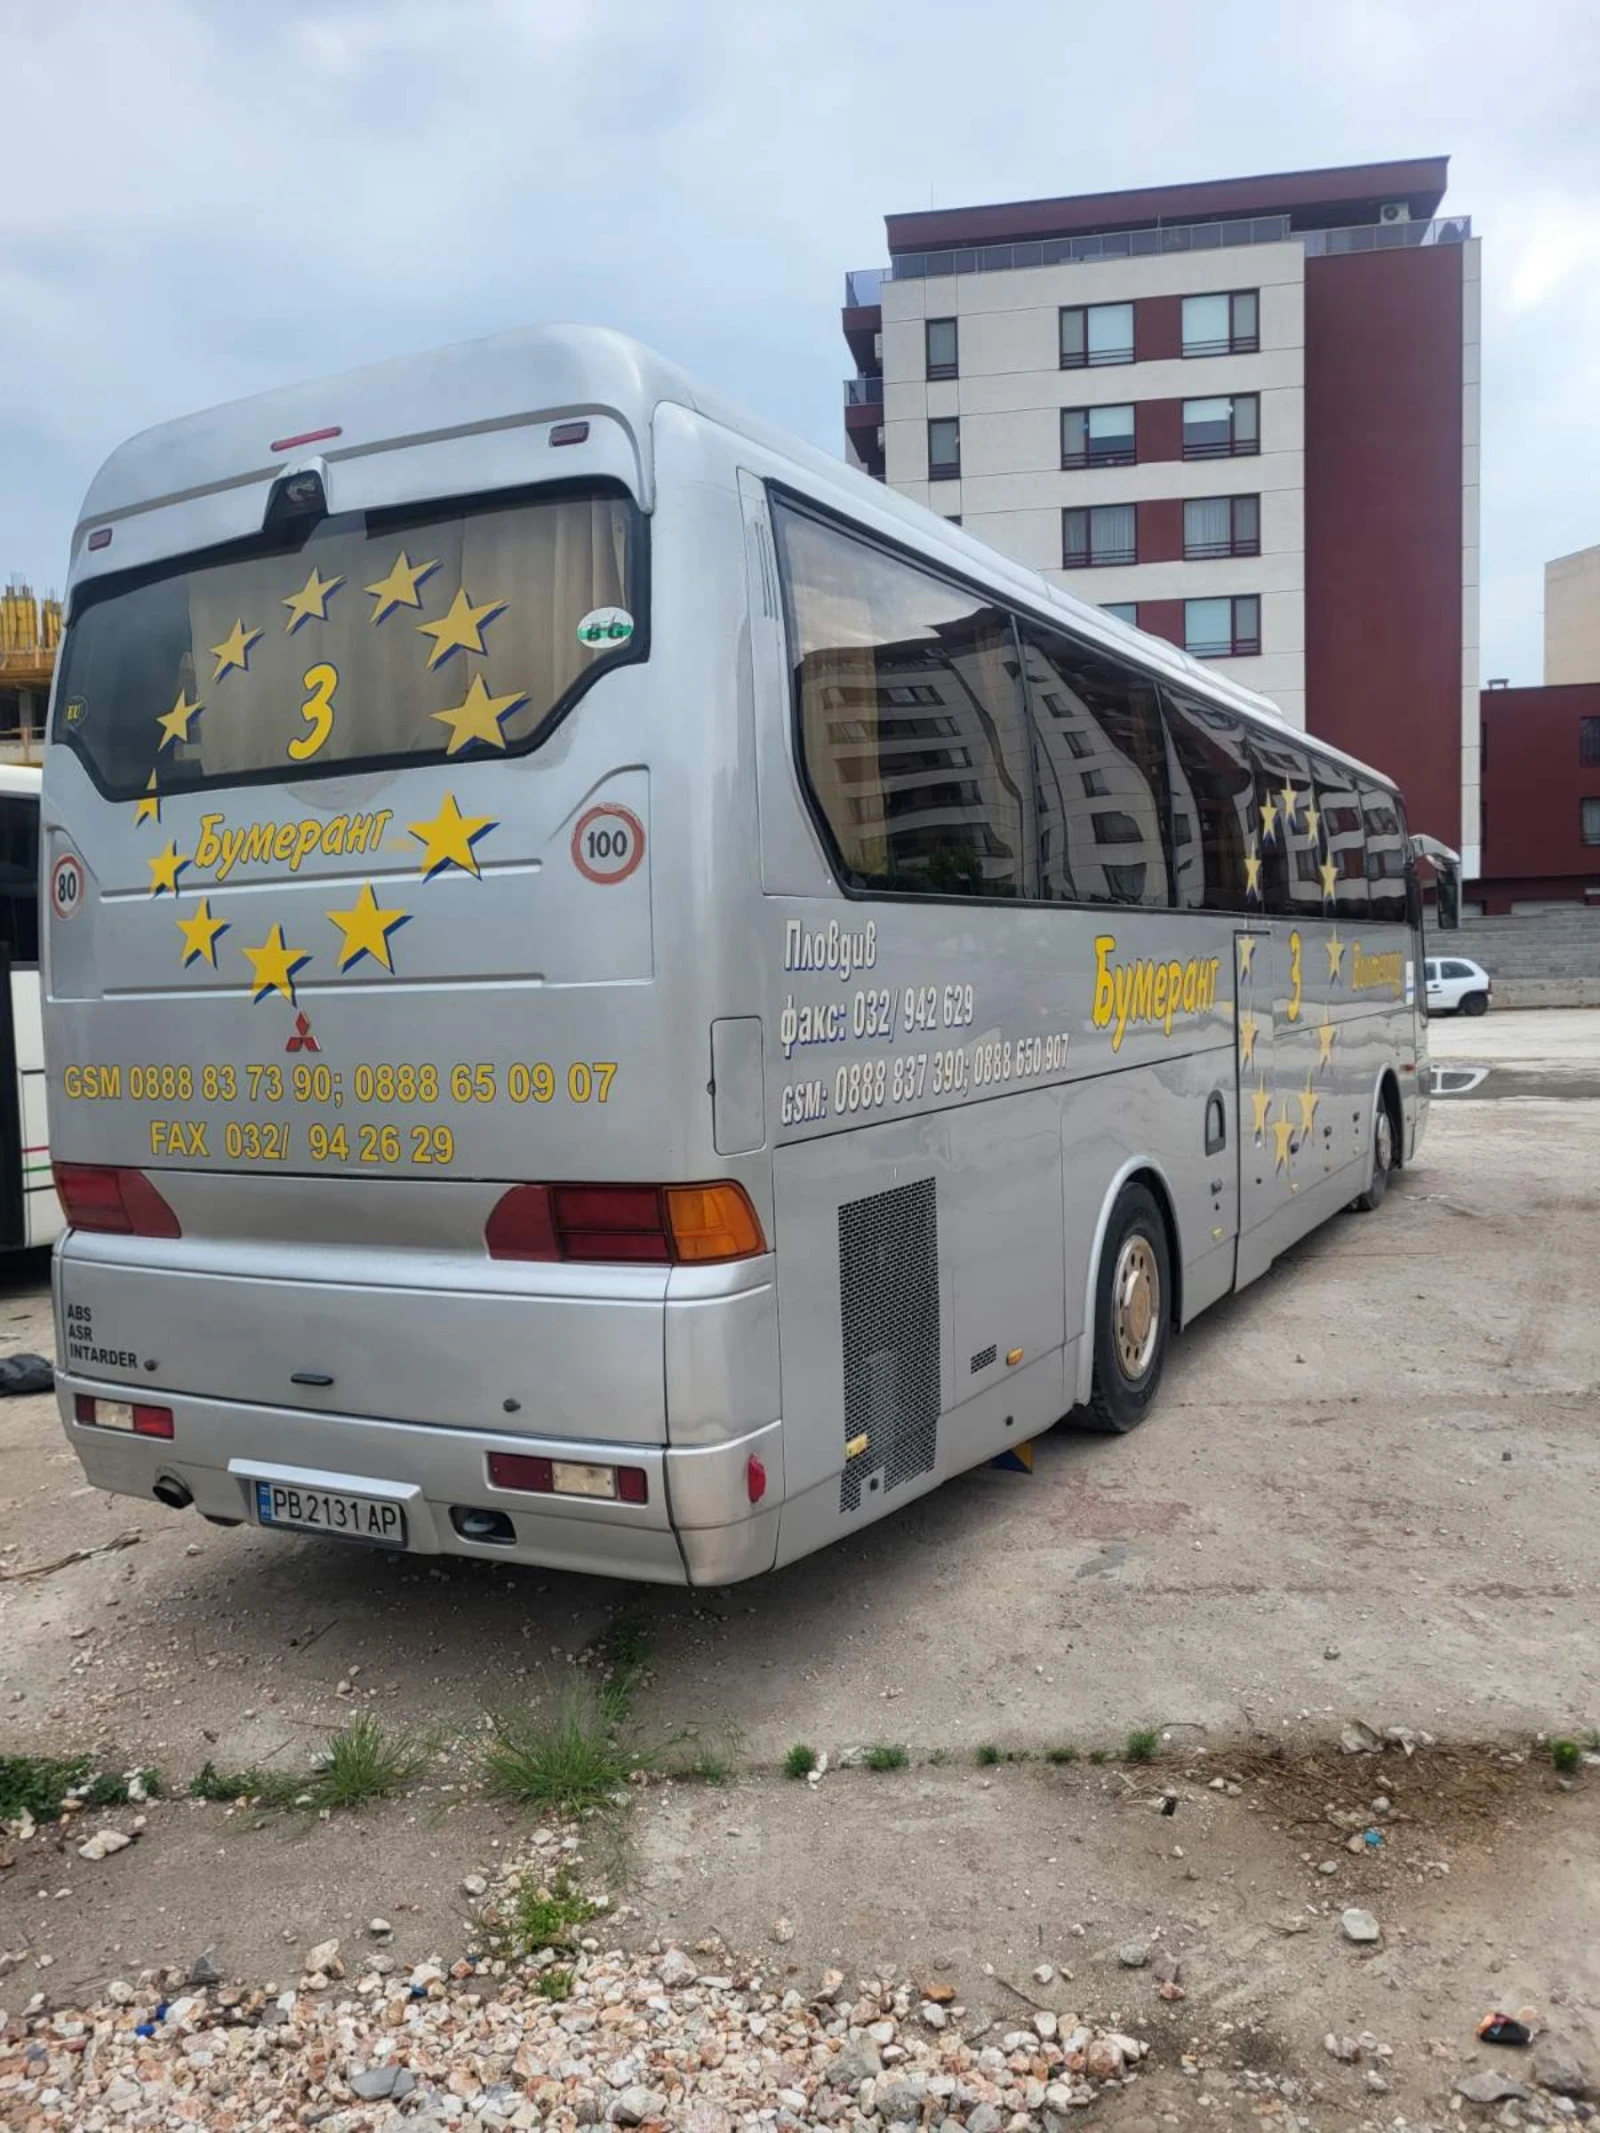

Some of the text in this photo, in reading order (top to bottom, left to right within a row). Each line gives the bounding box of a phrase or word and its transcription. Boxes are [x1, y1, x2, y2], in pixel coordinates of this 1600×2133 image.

[286, 662, 338, 761] 3
[194, 808, 394, 882] Бумеранг
[587, 829, 628, 859] 100
[58, 870, 77, 903] 80
[783, 919, 878, 981] Пловдив
[1286, 930, 1302, 1022] 3
[780, 983, 974, 1058] факс: 032/ 942 629
[1091, 934, 1221, 1053] Бумеранг
[63, 1061, 619, 1109] GSM 0888 83 73 90; 0888 65 09 07
[781, 1031, 1070, 1126] GSM: 0888 837 390; 0888 650 907
[149, 1120, 455, 1164] FAX 032/ 94 26 29
[67, 1303, 92, 1323] ABS
[68, 1323, 94, 1343] ASR
[70, 1343, 138, 1370] INTARDER
